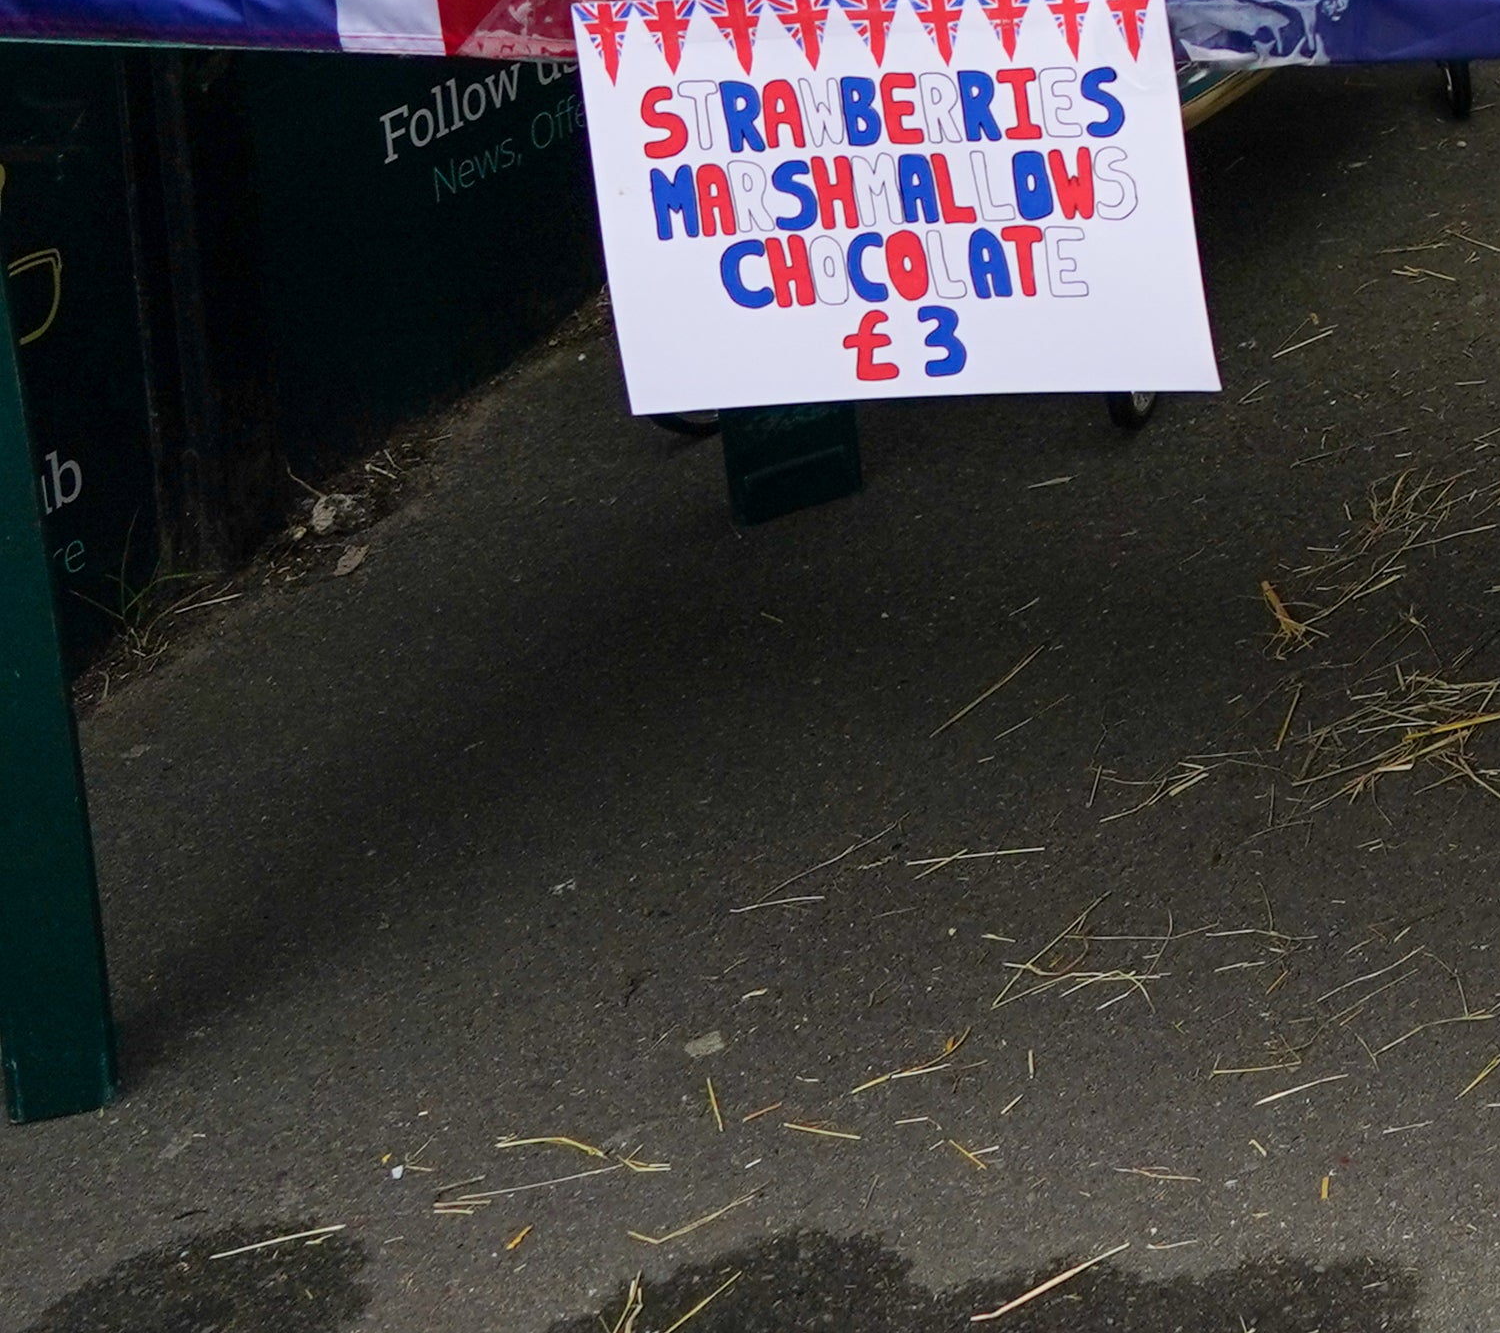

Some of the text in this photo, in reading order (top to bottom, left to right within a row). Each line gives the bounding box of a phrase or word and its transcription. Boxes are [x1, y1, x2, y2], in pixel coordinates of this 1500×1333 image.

[380, 62, 521, 165] Follow
[640, 67, 1125, 159] STRAWBERRIES
[650, 146, 1138, 240] MARSHMALLOWS
[720, 225, 1089, 308] CHOCOLATE
